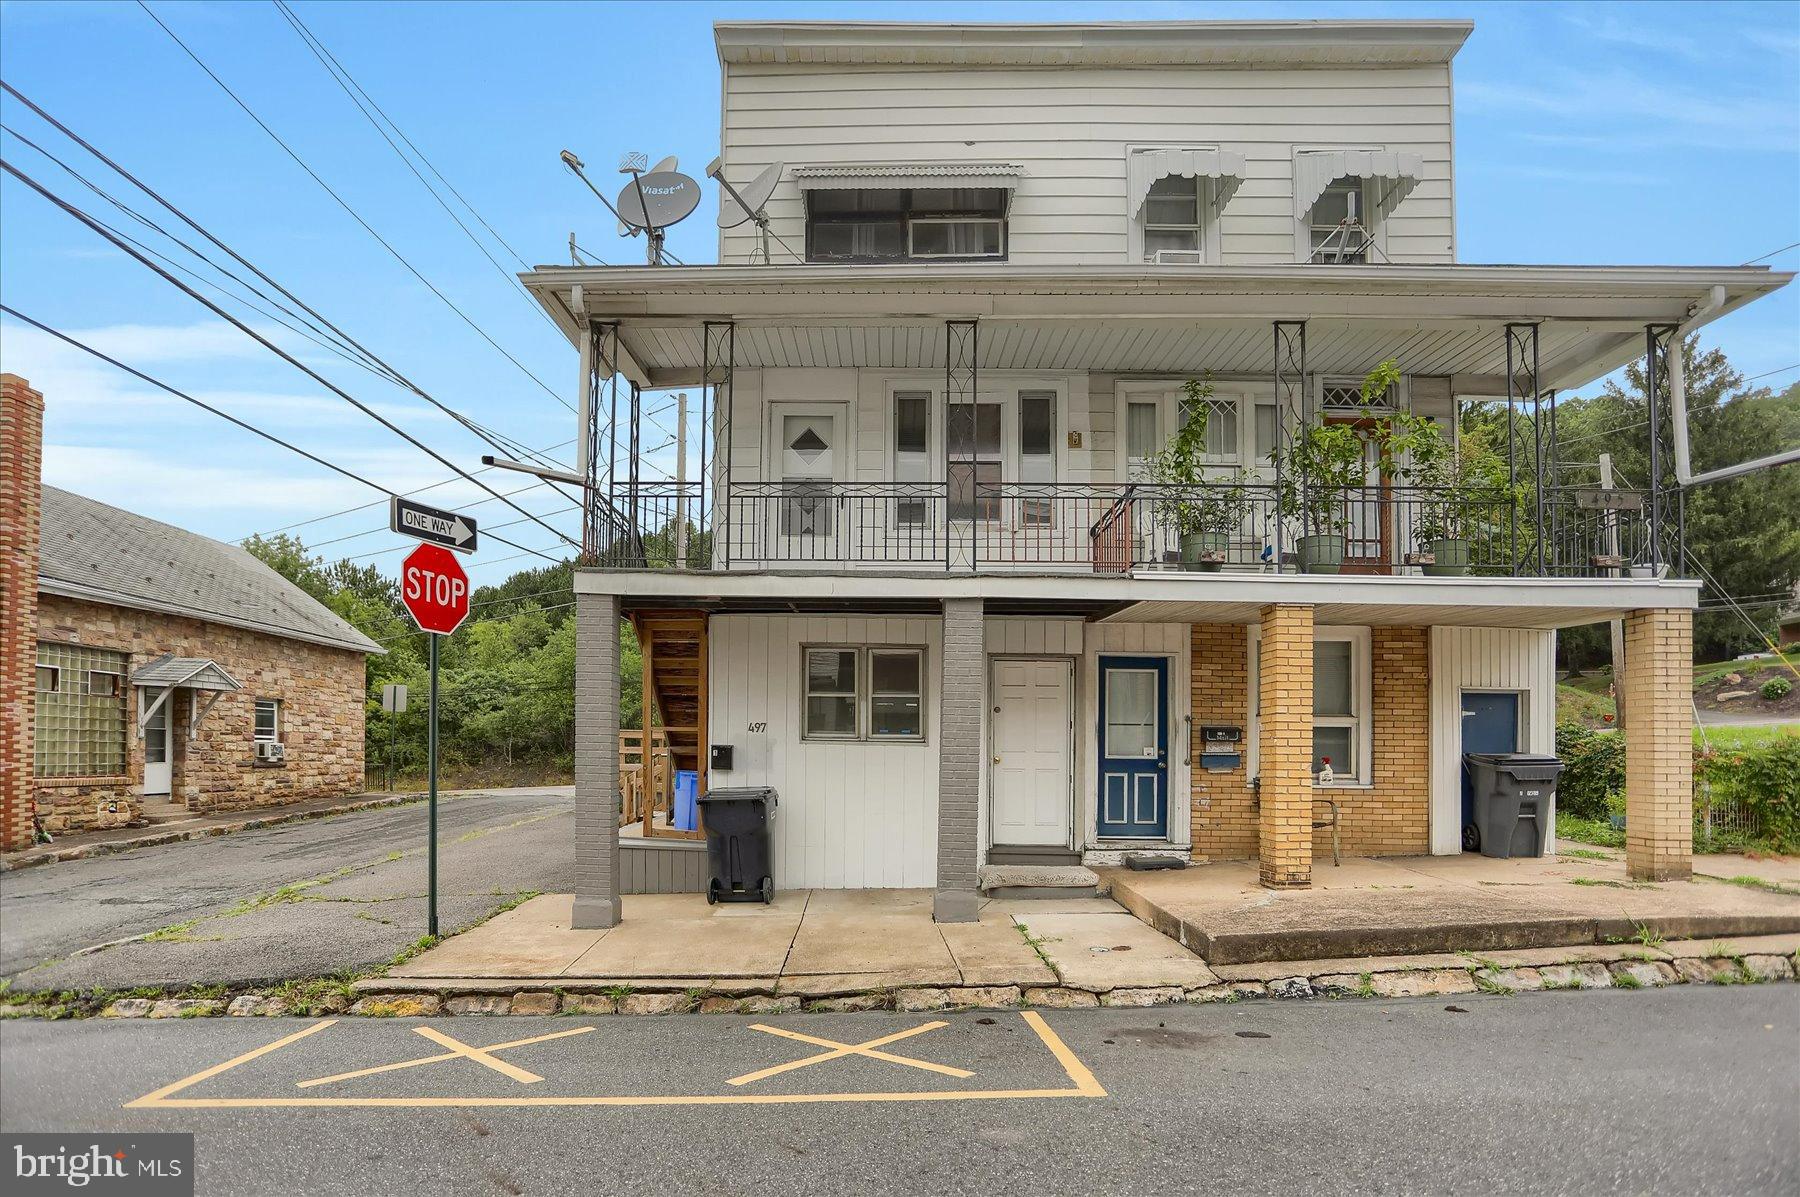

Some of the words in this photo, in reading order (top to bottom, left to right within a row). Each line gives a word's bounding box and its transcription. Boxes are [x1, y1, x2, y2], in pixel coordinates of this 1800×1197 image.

[642, 184, 675, 195] Viasat
[405, 511, 428, 529] ONE
[431, 518, 454, 535] WAY
[406, 567, 466, 608] STOP
[748, 722, 767, 733] 497
